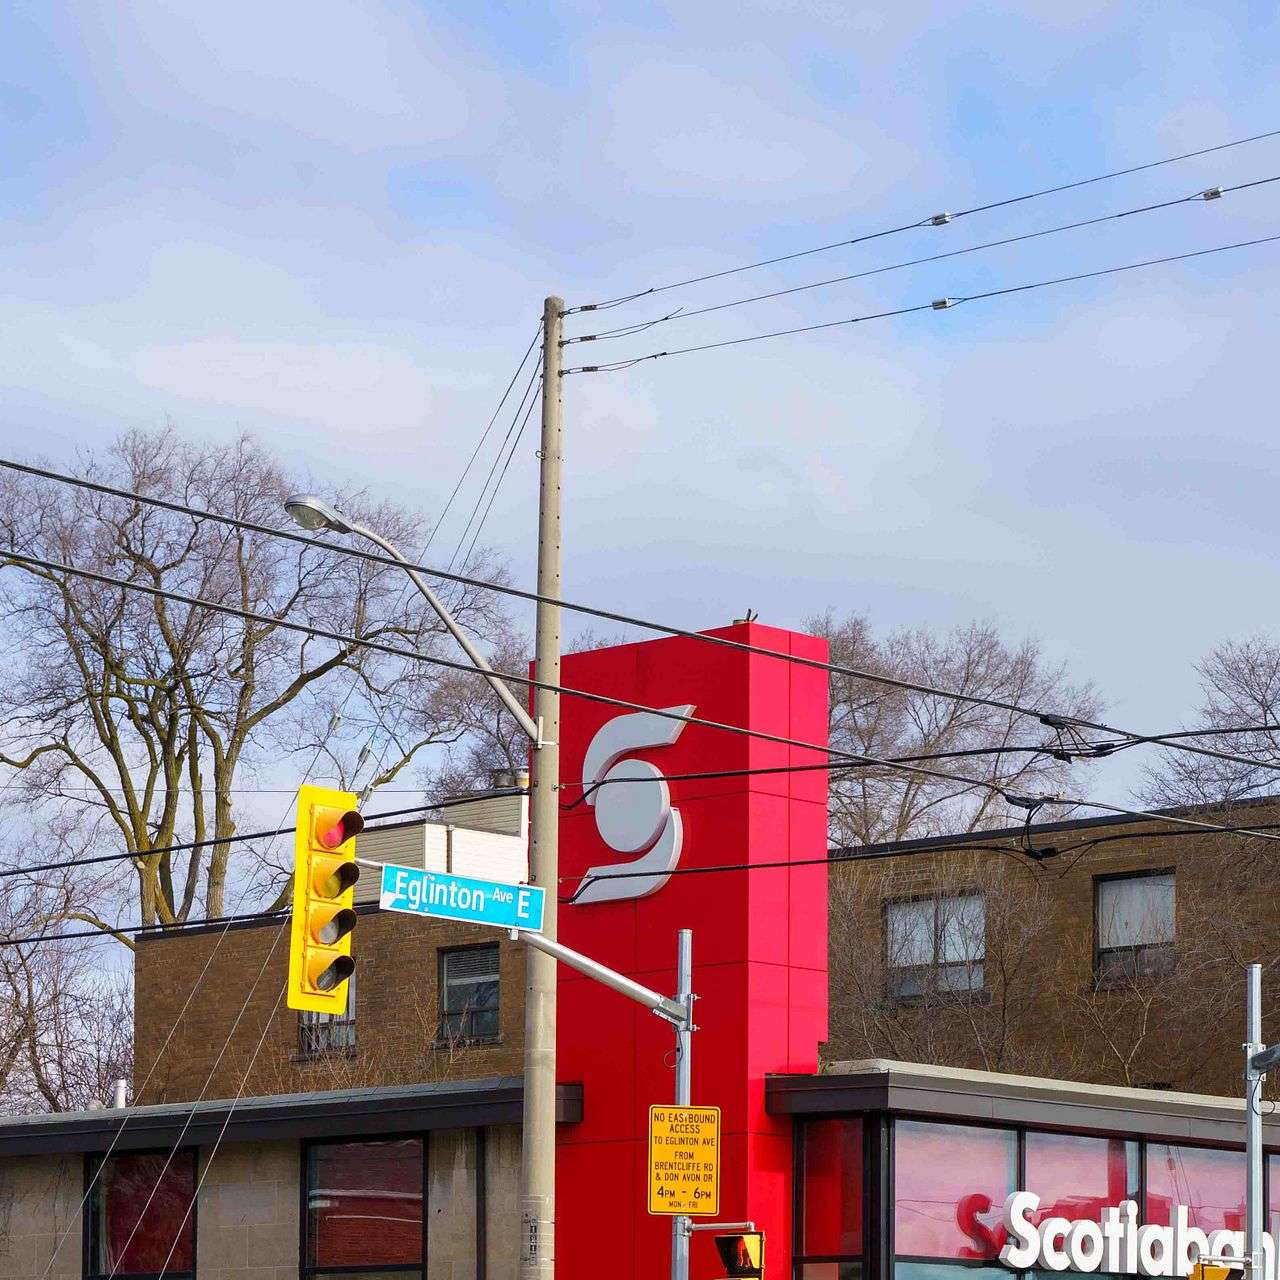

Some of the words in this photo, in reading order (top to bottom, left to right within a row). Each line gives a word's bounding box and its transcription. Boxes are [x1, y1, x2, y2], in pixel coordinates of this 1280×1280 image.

[395, 871, 485, 911] Eglinton
[493, 887, 513, 903] Ave
[518, 890, 531, 918] E
[654, 1112, 665, 1122] NO
[668, 1113, 716, 1124] EASTBOUND
[669, 1124, 700, 1134] ACCESS
[654, 1136, 662, 1144] TO
[665, 1136, 699, 1146] EGLINTON
[702, 1138, 715, 1146] AVE
[674, 1151, 694, 1160] FROM
[654, 1161, 700, 1171] BRENTCLIFFE
[704, 1163, 714, 1172] RD
[664, 1173, 679, 1181] DON
[682, 1174, 701, 1182] AVON
[703, 1174, 713, 1182] DR
[657, 1186, 675, 1198] 4PM
[694, 1187, 711, 1199] 6PM
